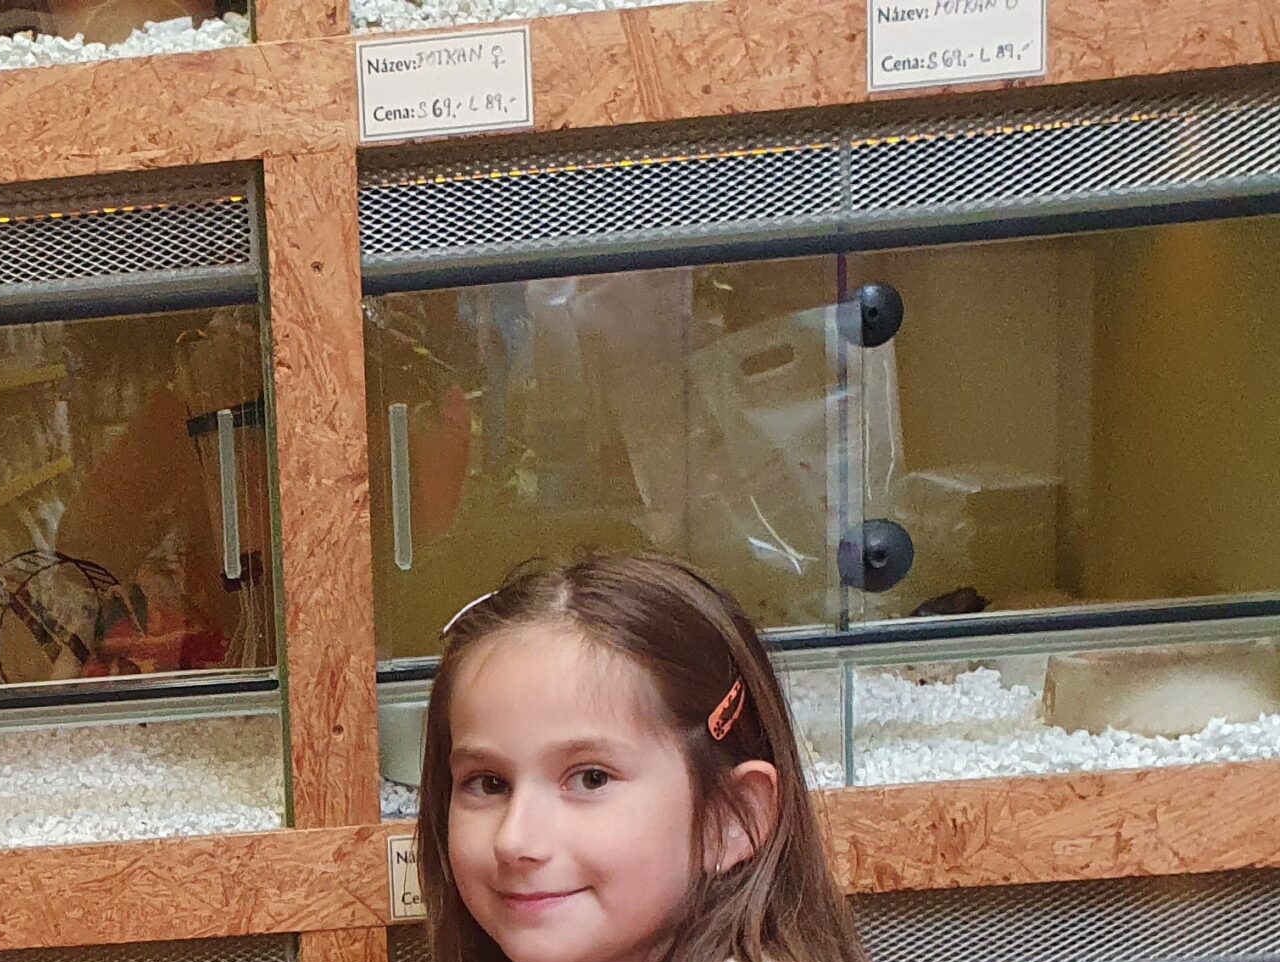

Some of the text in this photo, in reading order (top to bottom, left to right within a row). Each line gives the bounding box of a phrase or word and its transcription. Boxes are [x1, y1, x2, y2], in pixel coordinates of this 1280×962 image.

[878, 6, 928, 24] Název:
[367, 58, 417, 74] Název:
[881, 55, 925, 72] Cena:
[374, 105, 415, 122] Cena:
